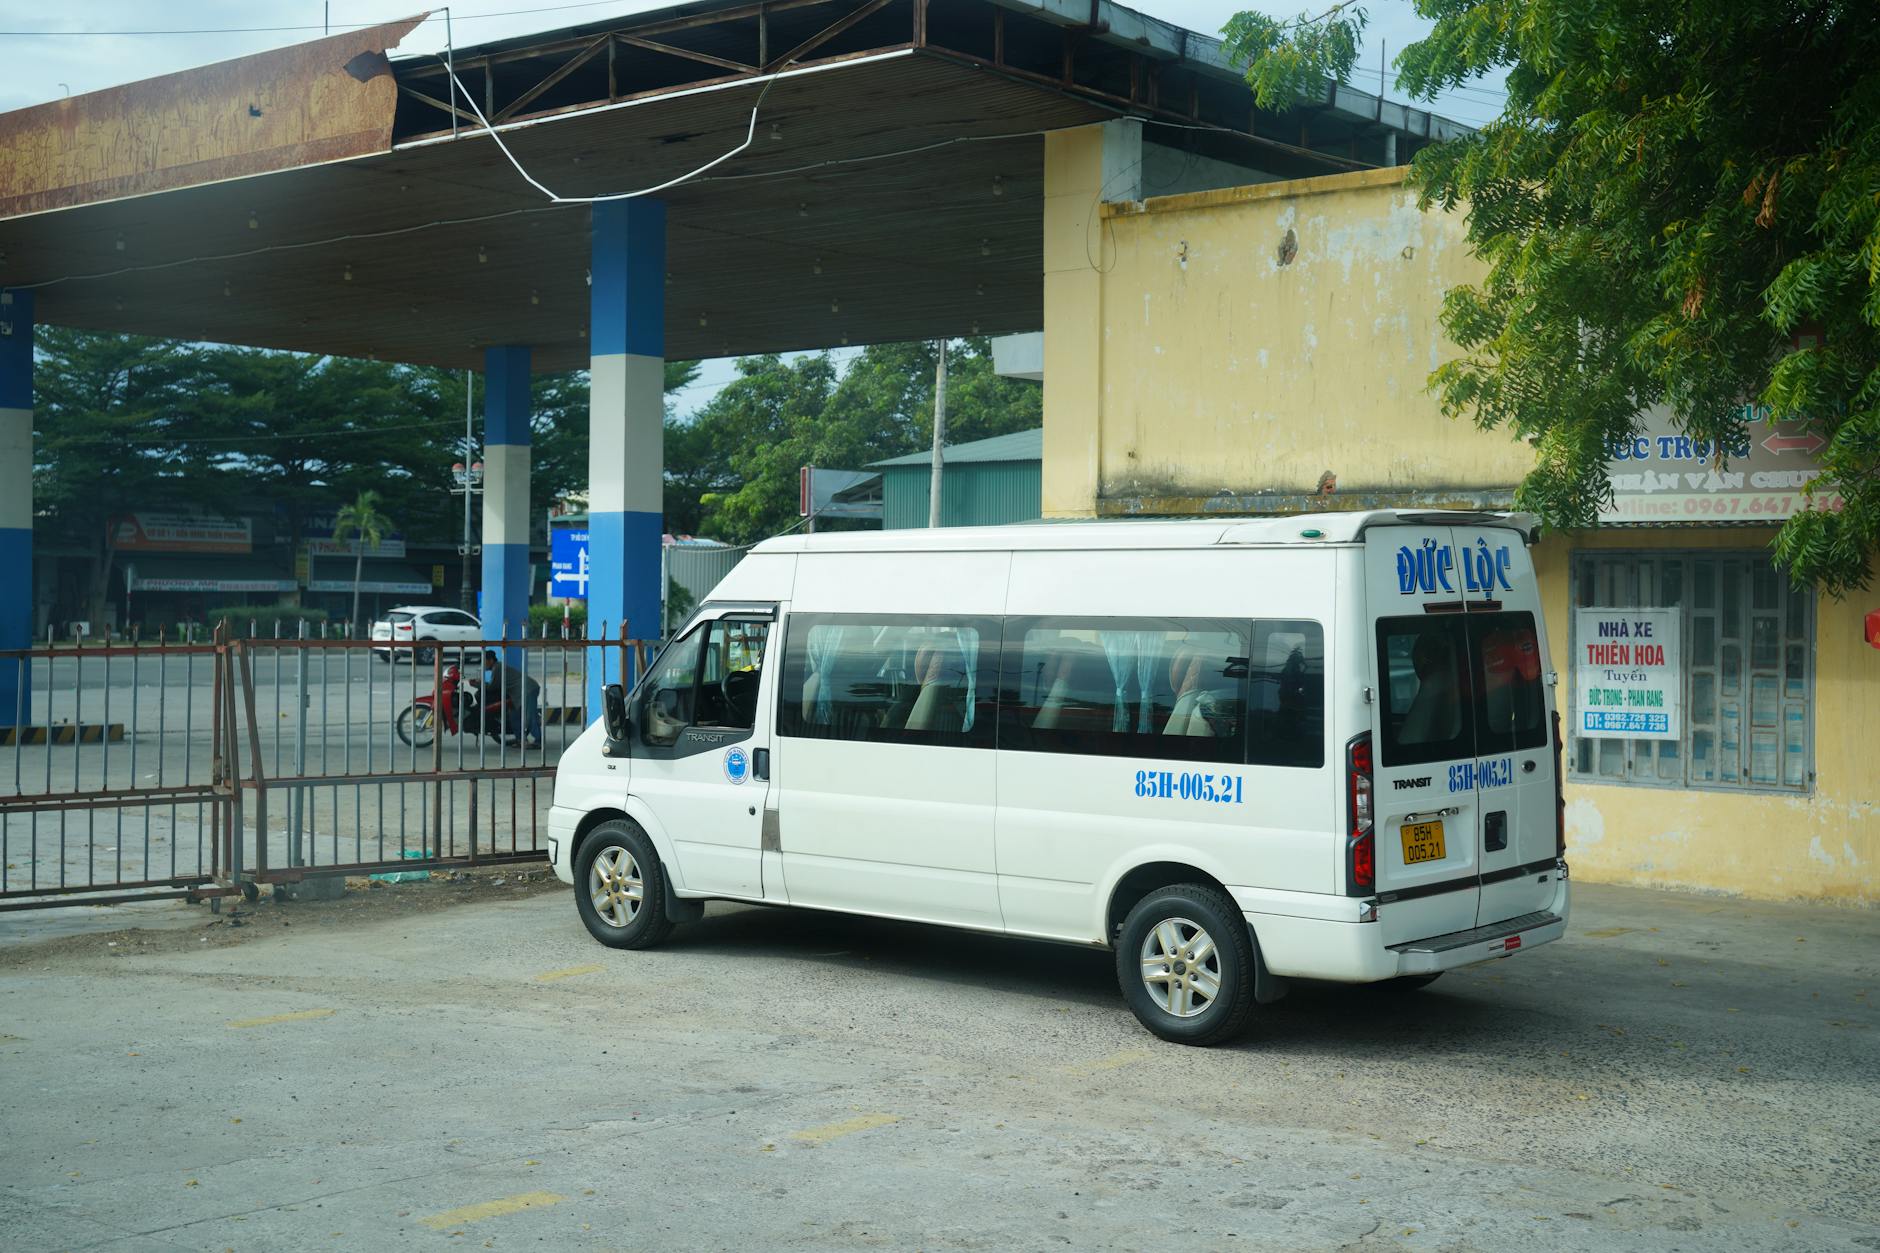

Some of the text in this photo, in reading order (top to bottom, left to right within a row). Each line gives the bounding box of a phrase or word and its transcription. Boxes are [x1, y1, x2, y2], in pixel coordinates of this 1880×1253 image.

[1397, 536, 1514, 601] ĐỨC LỘC
[1598, 618, 1653, 638] NHÀ XE
[1586, 640, 1665, 666] THIÊN HOA
[1604, 668, 1647, 684] Tuyến
[686, 732, 725, 744] TRANSIT
[1392, 776, 1432, 790] TRANSIT
[1448, 758, 1513, 793] 85H-005.21
[1135, 769, 1244, 804] 85H-005.21
[1413, 825, 1432, 842] 85H
[1408, 842, 1441, 862] 005.21
